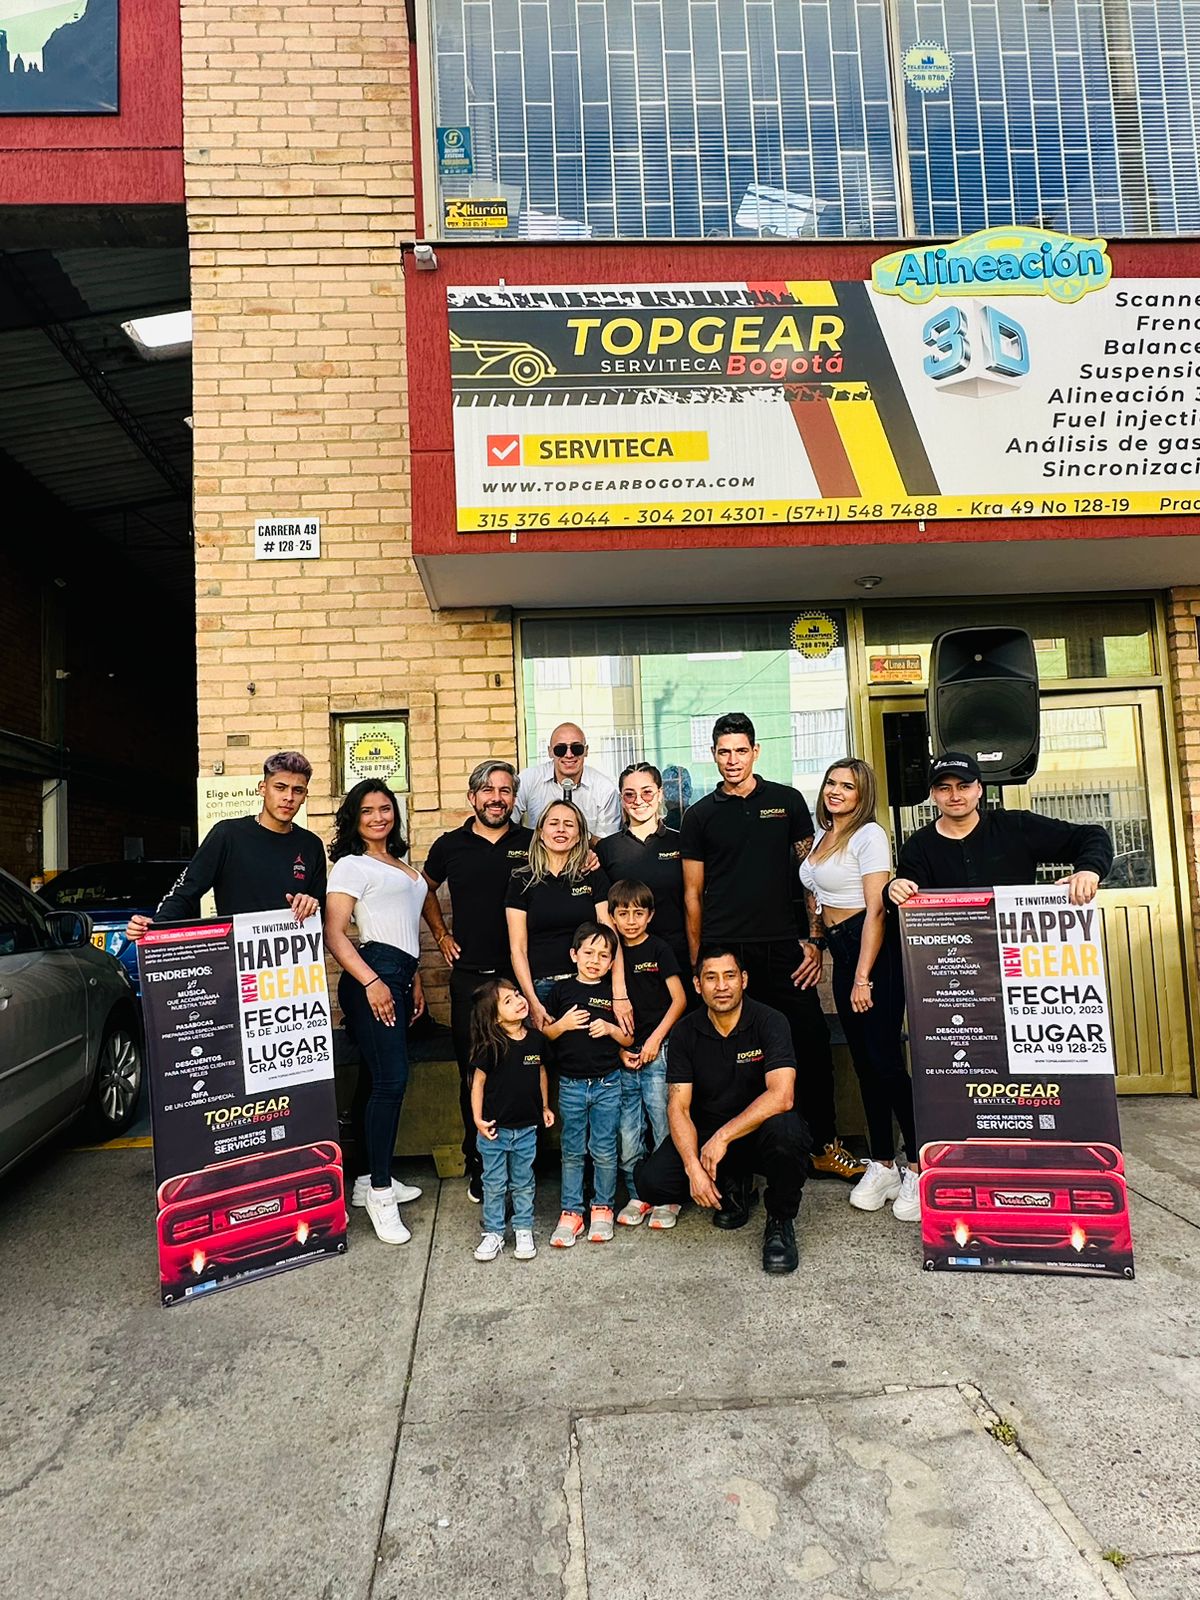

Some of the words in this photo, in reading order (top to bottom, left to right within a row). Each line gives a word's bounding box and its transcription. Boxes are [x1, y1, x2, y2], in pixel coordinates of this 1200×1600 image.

[467, 204, 506, 215] Hurón
[895, 242, 1104, 287] Alineación
[567, 315, 845, 356] TOPGEAR
[922, 304, 1031, 381] 3D
[601, 358, 722, 373] SERVITECA
[726, 352, 843, 379] Bogotá
[1047, 385, 1185, 404] Alineación
[1053, 411, 1106, 428] Fuel
[1116, 409, 1200, 430] injecti
[539, 438, 674, 460] SERVITECA
[1005, 435, 1108, 453] Análisis
[1119, 435, 1148, 451] de
[1043, 457, 1200, 477] Sincronizaci
[482, 477, 755, 493] WWW.TOPGEARBOGOTA.COM
[478, 514, 508, 528] 315
[515, 512, 551, 527] 376
[557, 511, 610, 526] 4044
[637, 509, 674, 524] 304
[681, 508, 713, 523] 201
[720, 507, 765, 521] 4301
[786, 505, 840, 522] (57+1)
[847, 504, 883, 518] 548
[891, 503, 938, 517] 7488
[971, 502, 1003, 515] Kra
[1010, 501, 1034, 514] 49
[1041, 501, 1067, 513] No
[1074, 498, 1130, 512] 128-19
[258, 525, 301, 537] CARRERA
[304, 524, 317, 535] 49
[206, 789, 229, 800] Elige
[246, 788, 260, 796] lub
[206, 801, 223, 809] con
[226, 800, 254, 808] menor
[1015, 897, 1024, 906] TE
[1025, 895, 1067, 906] INVITAMOS
[252, 925, 261, 934] TE
[262, 921, 299, 933] INVITAMOS
[998, 909, 1094, 944] HAPPY
[906, 934, 973, 945] TENDREMOS:
[237, 932, 321, 971] HAPPY
[1002, 946, 1022, 977] NEW
[1022, 943, 1100, 978] GEAR
[145, 965, 213, 982] TENDREMOS:
[240, 973, 259, 1003] NEW
[258, 964, 325, 1002] GEAR
[1007, 985, 1103, 1005] FECHA
[244, 1001, 327, 1029] FECHA
[1009, 1006, 1019, 1015] 15
[1022, 1006, 1038, 1015] DE
[1041, 1006, 1076, 1015] JULIO,
[1079, 1005, 1104, 1014] 2023
[175, 1020, 214, 1030] PASABOCAS
[246, 1030, 255, 1038] 15
[258, 1028, 272, 1037] DE
[274, 1022, 304, 1034] JULIO,
[307, 1018, 328, 1029] 2023
[1011, 1023, 1105, 1043] LUGAR
[248, 1035, 328, 1064] LUGAR
[1013, 1043, 1045, 1053] CRA
[1047, 1043, 1063, 1053] 49
[1067, 1043, 1107, 1053] 128-25
[175, 1055, 222, 1069] DESCUENTOS
[249, 1061, 277, 1074] CRA
[280, 1058, 293, 1068] 49
[297, 1052, 330, 1065] 128-25
[191, 1091, 209, 1100] RIFA
[965, 1083, 1060, 1098] TOPGEAR
[174, 1102, 184, 1110] UN
[184, 1098, 207, 1108] COMBO
[207, 1093, 236, 1103] ESPECIAL
[204, 1096, 290, 1125] TOPGEAR
[1017, 1097, 1061, 1107] Bogotá
[211, 1117, 252, 1131] SERVITECA
[976, 1120, 1034, 1130] SERVICIOS
[214, 1136, 237, 1146] CONOCE
[238, 1130, 266, 1140] NUESTROS
[214, 1135, 267, 1155] SERVICIOS
